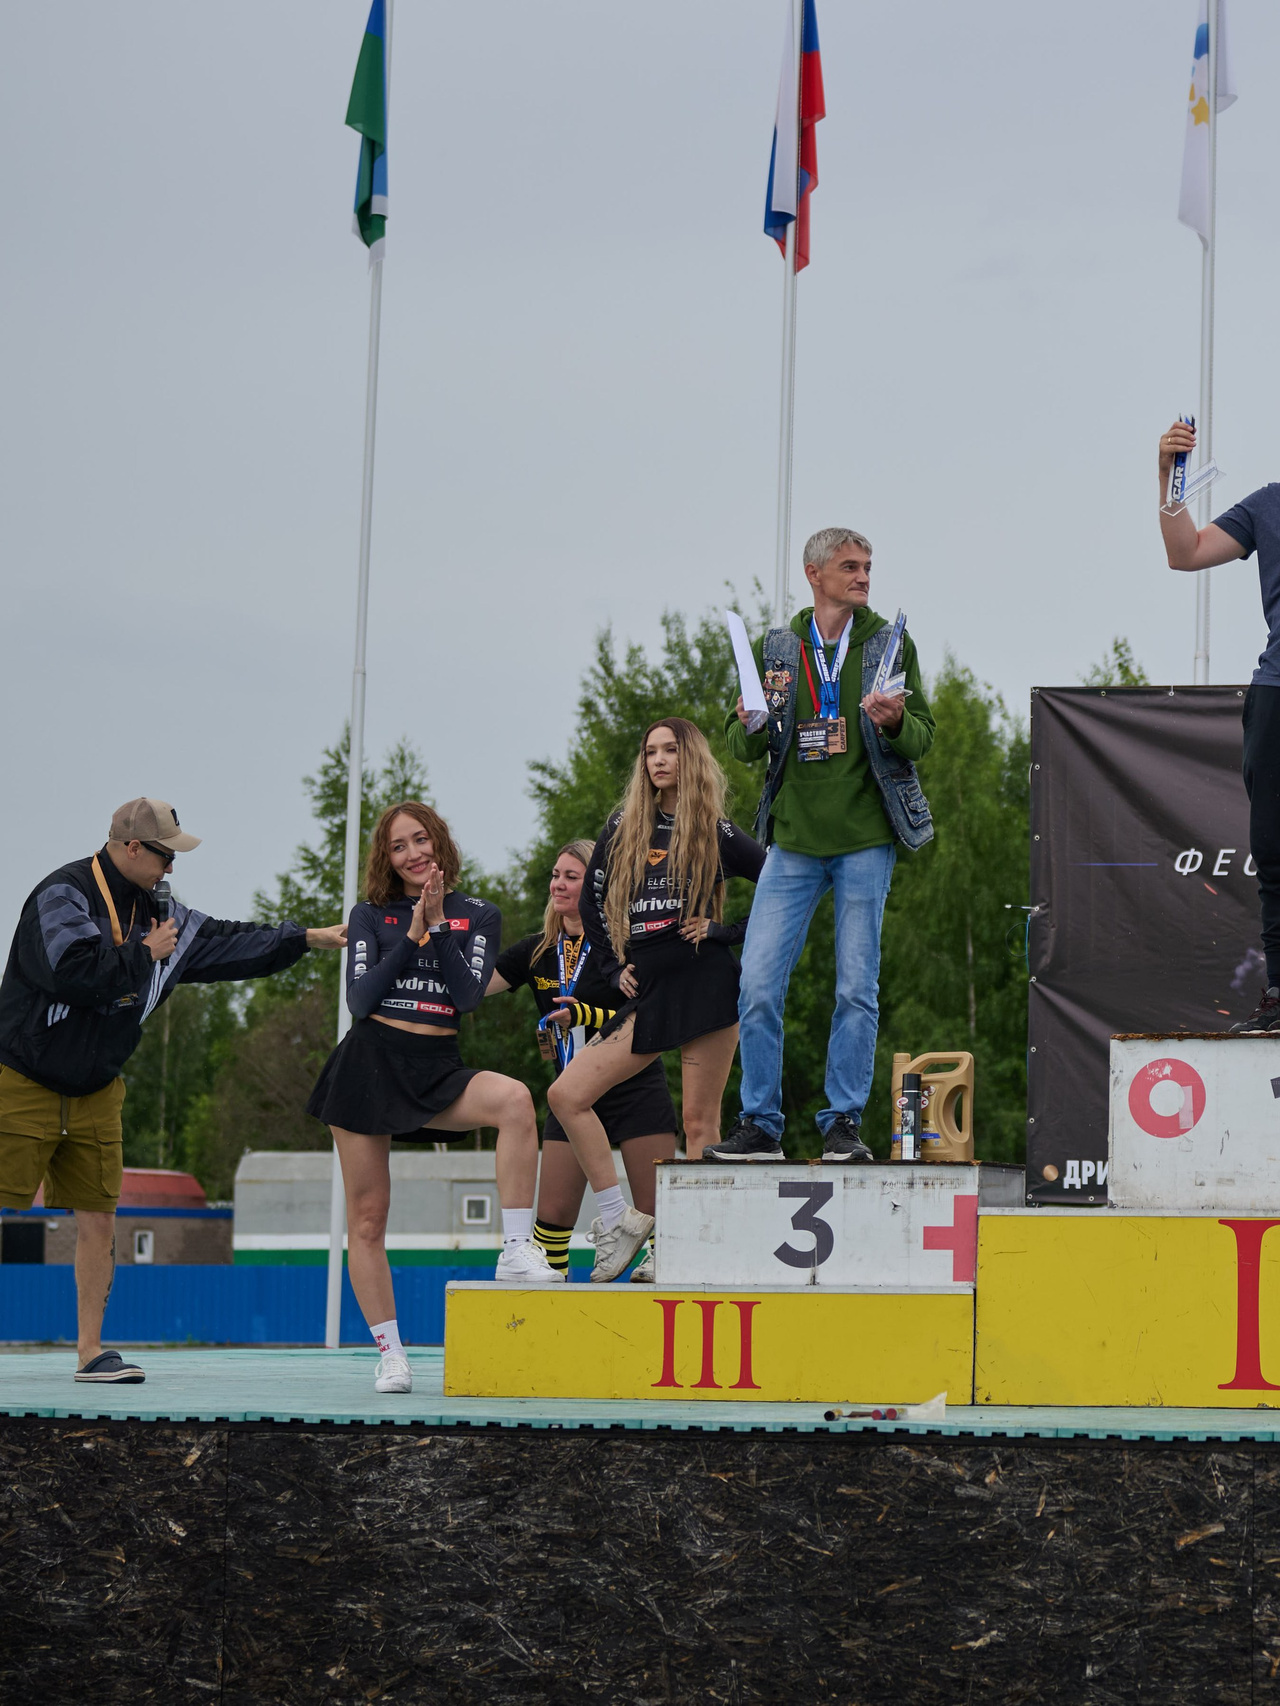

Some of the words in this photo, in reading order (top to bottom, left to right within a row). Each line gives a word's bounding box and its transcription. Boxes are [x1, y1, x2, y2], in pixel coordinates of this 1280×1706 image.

[420, 1003, 454, 1015] GOLD
[1063, 1160, 1109, 1190] ДРИ
[773, 1181, 835, 1269] 3
[650, 1299, 762, 1390] III
